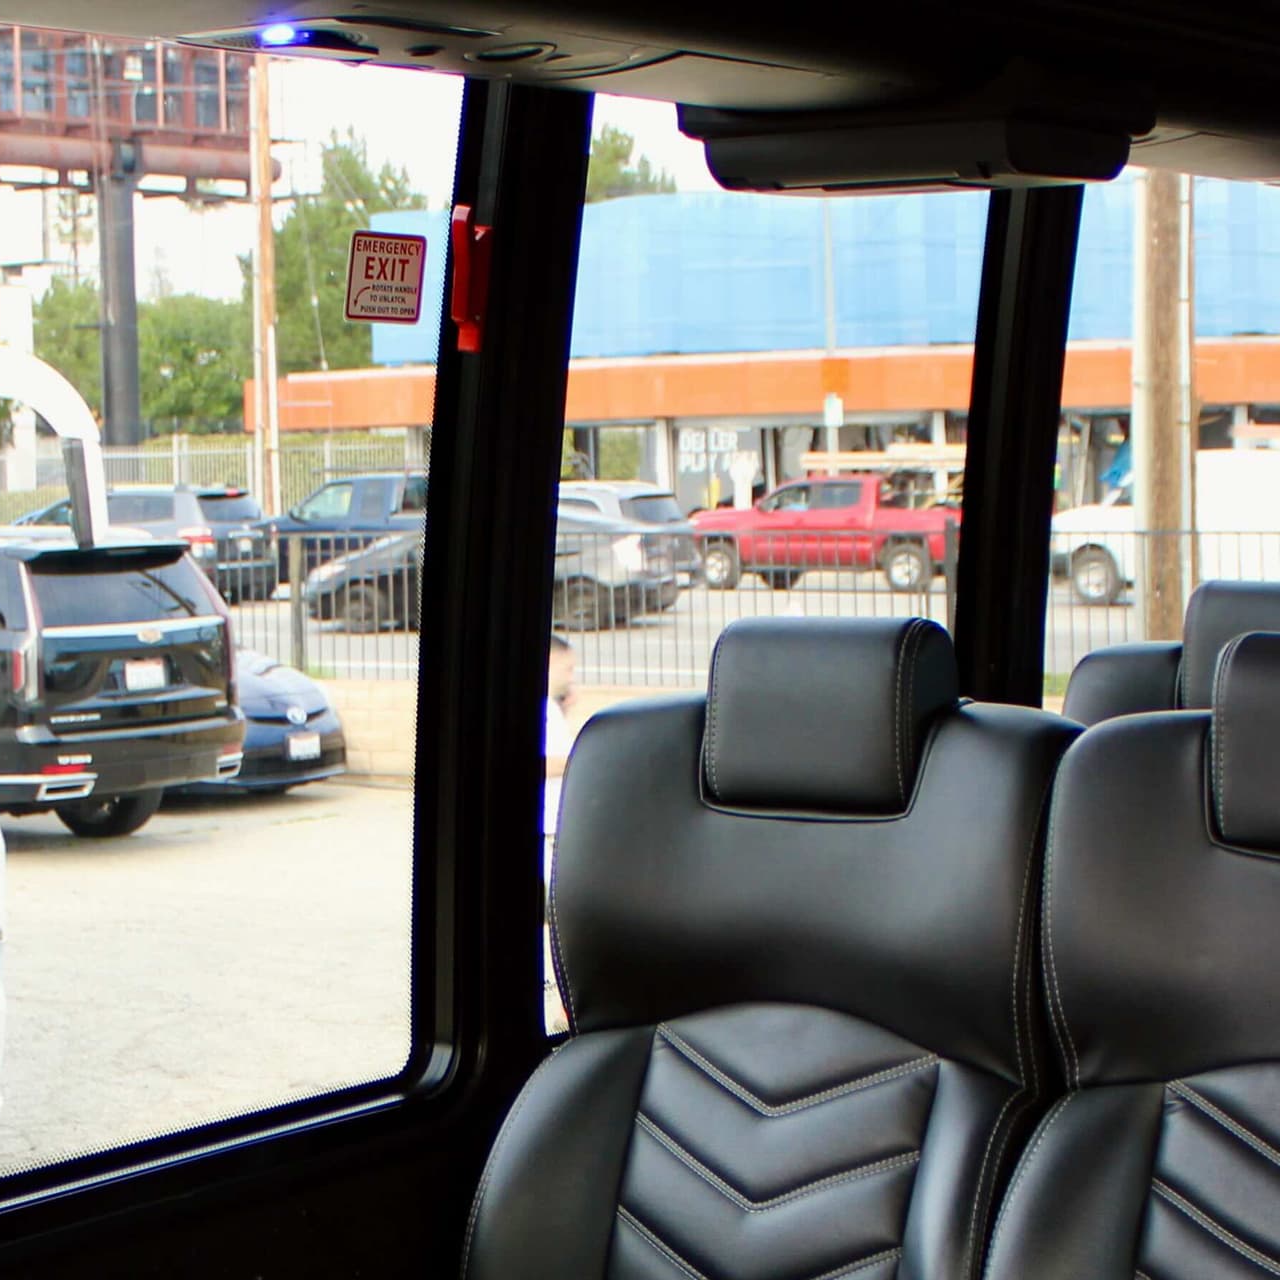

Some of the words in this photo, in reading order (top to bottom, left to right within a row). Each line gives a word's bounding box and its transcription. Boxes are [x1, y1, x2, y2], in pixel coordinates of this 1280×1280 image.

[356, 240, 421, 256] EMERGENCY
[364, 256, 410, 282] EXIT
[372, 284, 393, 292] ROTATE
[370, 294, 378, 302] TO
[360, 305, 376, 313] PUSH
[377, 306, 389, 314] OUT
[399, 308, 416, 316] OPEN
